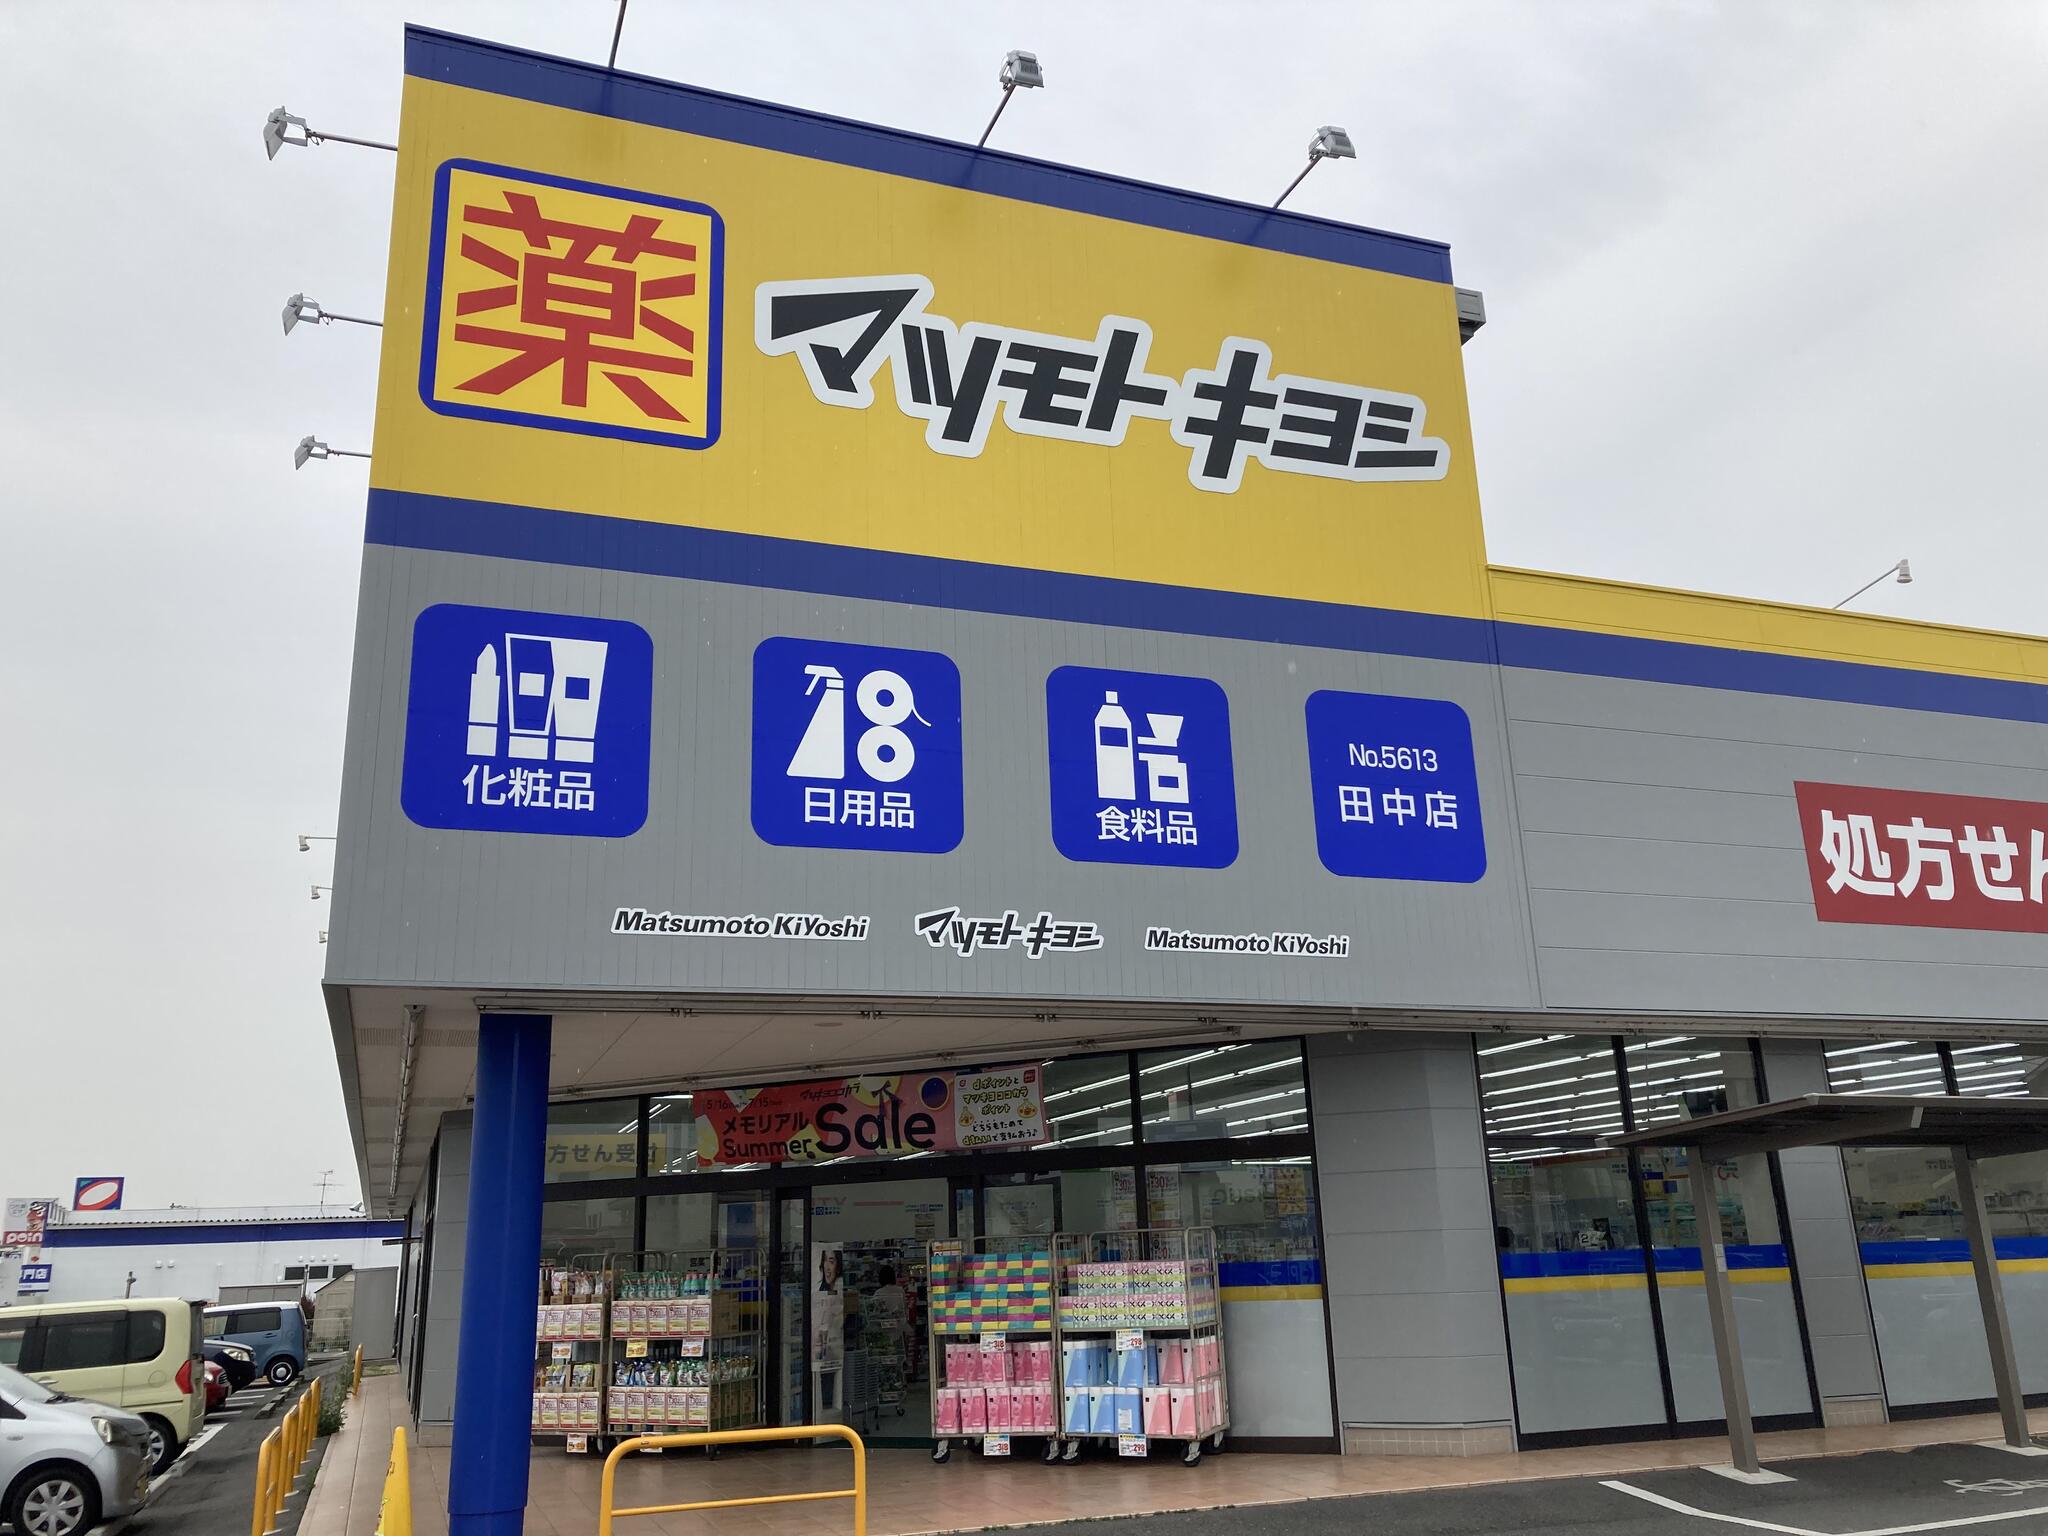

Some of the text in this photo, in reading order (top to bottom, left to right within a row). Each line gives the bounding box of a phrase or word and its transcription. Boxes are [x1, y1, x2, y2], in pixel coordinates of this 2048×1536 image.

[454, 191, 697, 423] 薬
[771, 288, 1437, 480] マツモトキヨシ
[1349, 743, 1438, 772] No.5613
[462, 764, 596, 811] 化粧品
[803, 787, 915, 829] 日用品
[1338, 785, 1458, 830] 田中店
[1096, 805, 1198, 846] 食料品
[615, 910, 867, 938] Matsumoto KiYoshi
[918, 909, 1101, 955] マツモトキヨシ
[1148, 929, 1347, 955] Matsumoto KiYoshi
[722, 1112, 809, 1135] メモリアル
[815, 1096, 937, 1153] Sale
[723, 1138, 812, 1159] Summer
[21, 1268, 48, 1280] 門店
